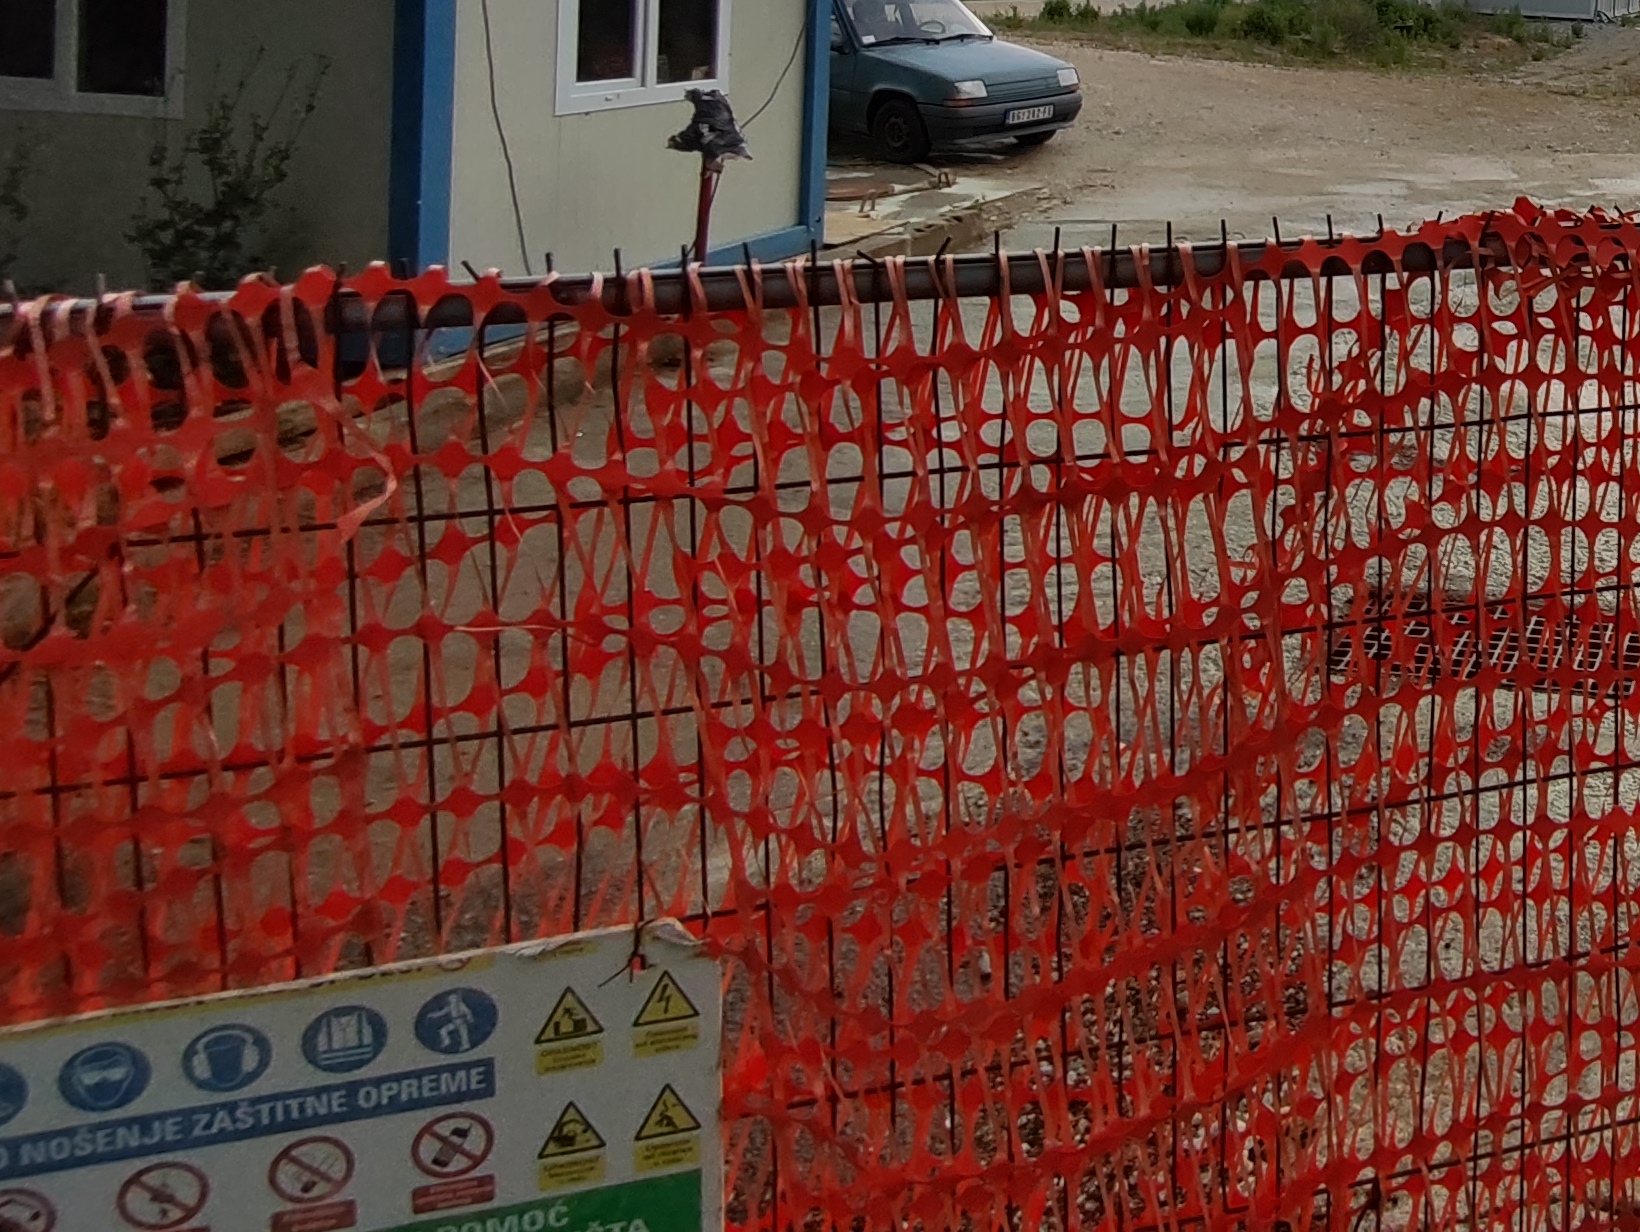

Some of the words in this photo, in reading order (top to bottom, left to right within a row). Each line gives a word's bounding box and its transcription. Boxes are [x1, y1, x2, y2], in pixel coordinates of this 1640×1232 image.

[18, 1115, 184, 1166] NOŠENJE
[191, 1089, 348, 1136] ZAŠTITNE
[356, 1065, 487, 1108] OPREME
[437, 1199, 570, 1232] MOĆ
